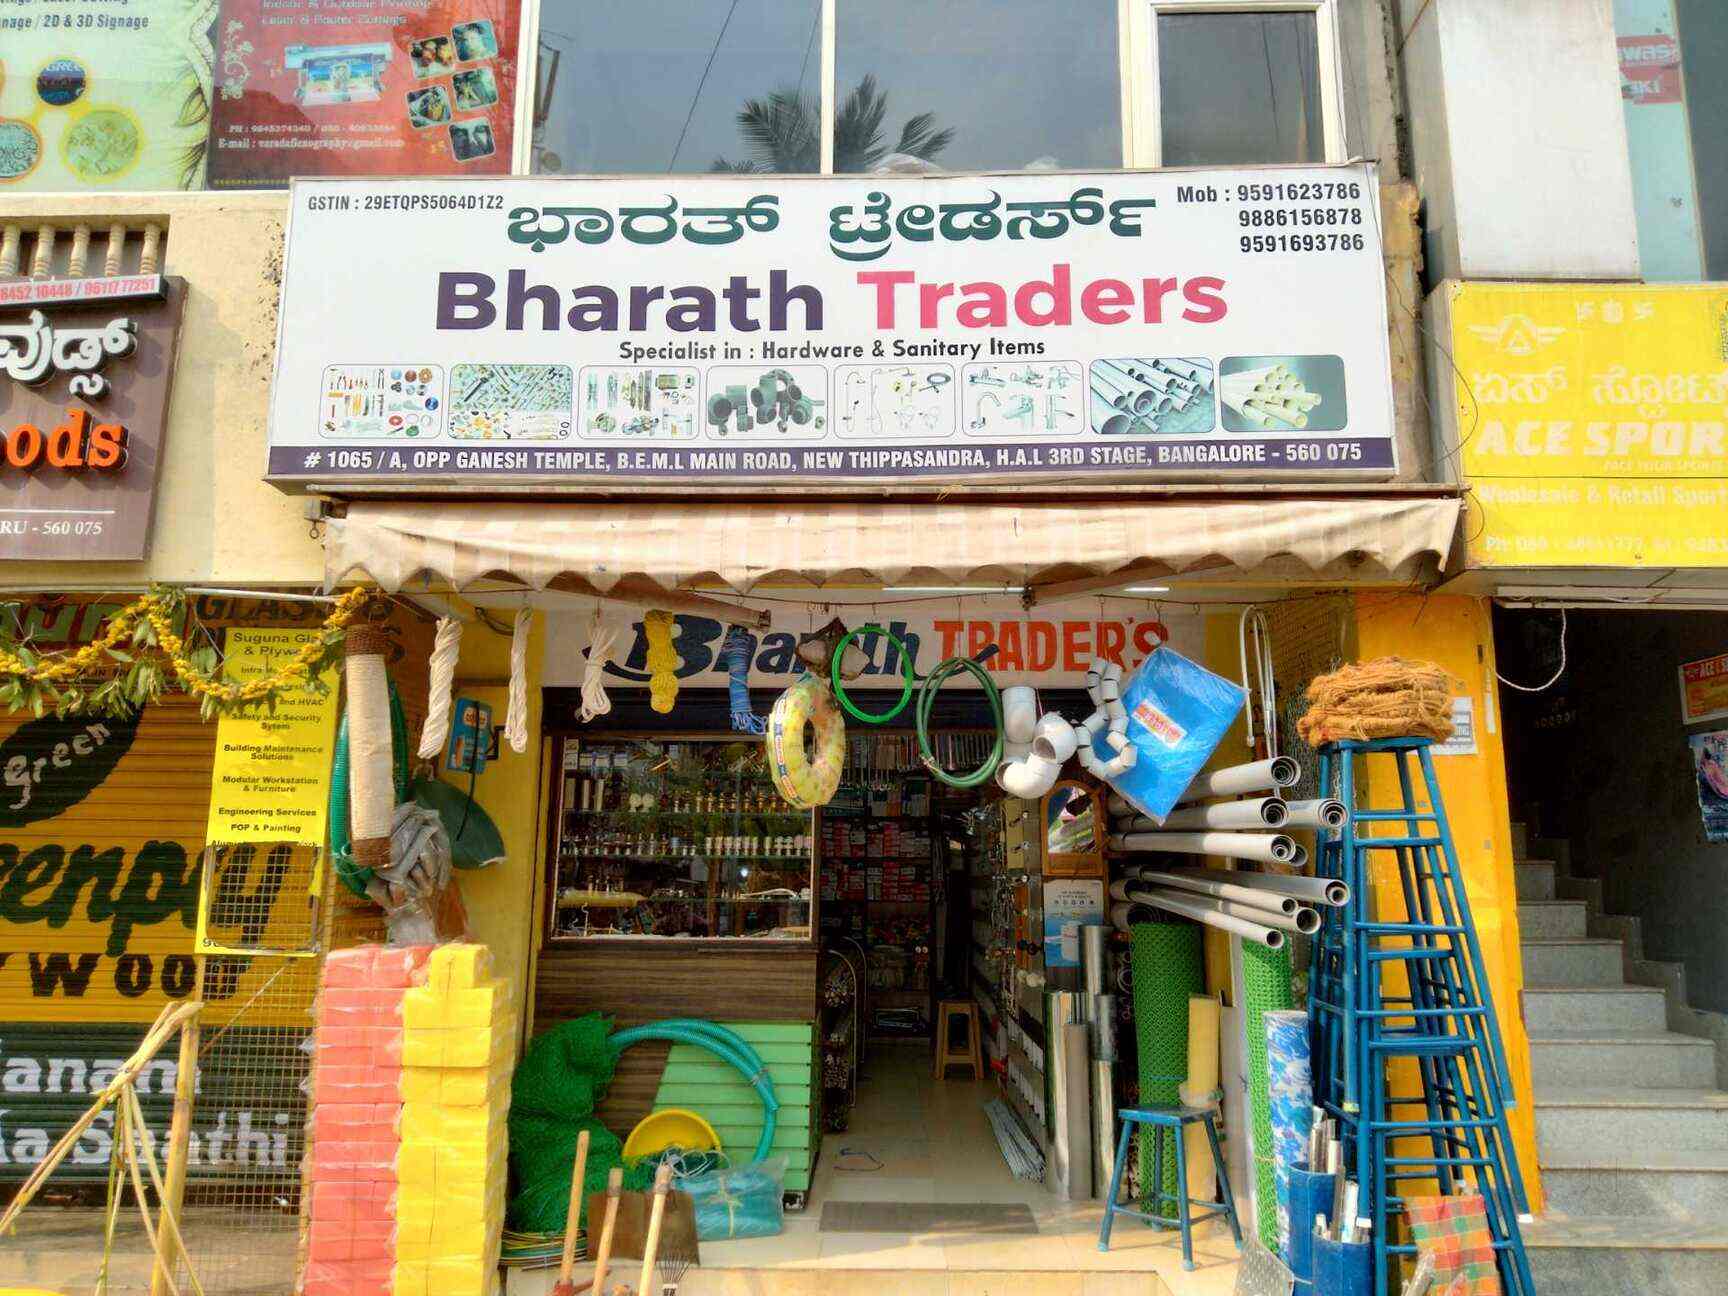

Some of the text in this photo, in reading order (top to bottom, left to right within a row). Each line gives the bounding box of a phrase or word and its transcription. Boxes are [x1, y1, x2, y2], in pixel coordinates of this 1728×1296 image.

[43, 14, 60, 28] 2D
[64, 14, 72, 28] &
[76, 14, 93, 28] 3D
[97, 14, 149, 31] Signage
[1178, 186, 1217, 202] Mob
[1237, 183, 1361, 202] 9591623786
[309, 195, 349, 210] GSTIN
[1239, 207, 1362, 227] 9886156878
[1240, 233, 1364, 253] 9591693786
[437, 264, 1228, 332] Bharath Traders
[619, 342, 716, 362] Specialist
[725, 341, 741, 359] in
[763, 340, 863, 359] Hardware
[872, 340, 885, 358] &
[893, 340, 981, 361] Sanitary
[990, 340, 1045, 358] Items
[1476, 421, 1574, 456] ACE
[303, 451, 322, 469] #
[328, 450, 372, 469] 1065
[414, 450, 454, 469] OPP
[456, 450, 529, 470] GANESH
[534, 451, 611, 472] TEMPLE,
[617, 451, 684, 470] B.E.M.L
[690, 450, 737, 470] MAIN
[743, 449, 797, 471] ROAD,
[803, 448, 844, 468] NEW
[849, 447, 990, 469] THIPPASANDRA,
[996, 446, 1043, 466] H.A.L
[1049, 446, 1085, 466] 3RD
[1090, 446, 1153, 468] STAGE,
[1158, 444, 1266, 464] BANGALORE
[1286, 443, 1321, 462] 560
[1327, 442, 1362, 461] 075
[42, 519, 70, 535] 560
[75, 519, 104, 535] 075
[233, 632, 289, 645] Suguna
[243, 646, 253, 656] &
[297, 698, 325, 707] HVAC
[231, 712, 322, 724] Safety and Security
[223, 744, 323, 754] Building Maintenance
[250, 753, 294, 761] Solutions
[4, 723, 111, 811] green
[222, 776, 320, 785] Modular Workstation
[253, 785, 296, 793] Furniture
[218, 807, 317, 817] Engineering Services
[253, 823, 260, 832] &
[263, 823, 302, 834] Painting
